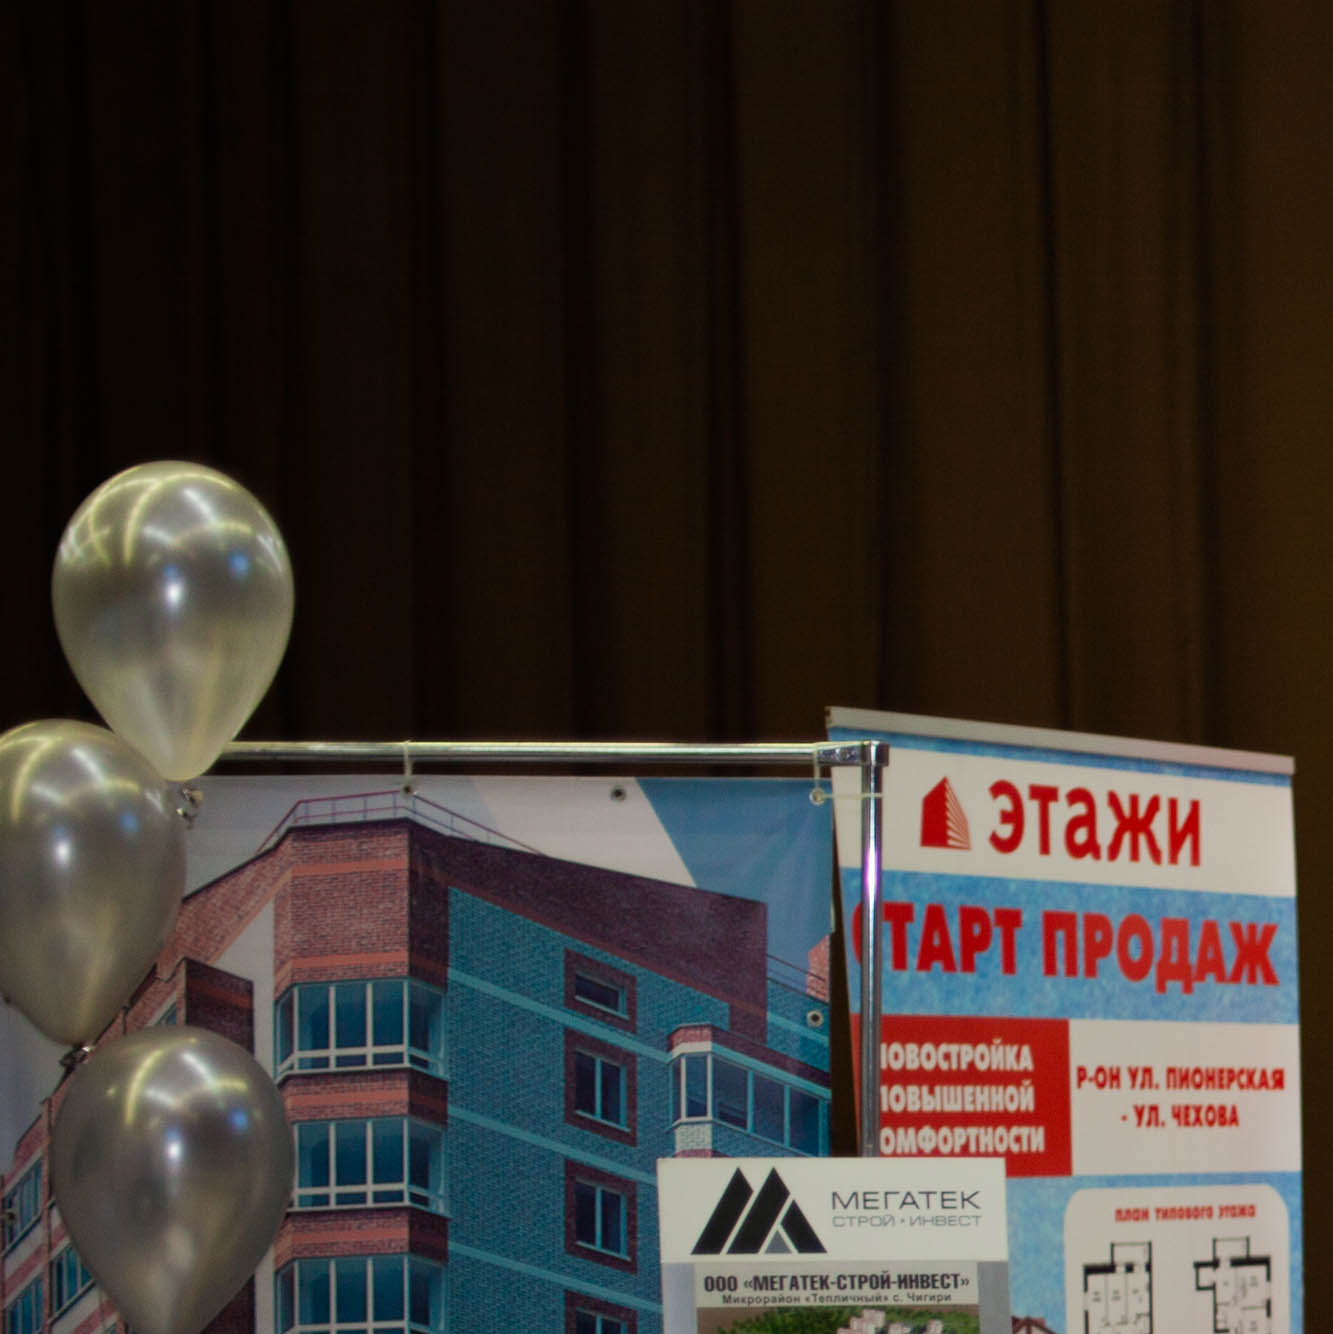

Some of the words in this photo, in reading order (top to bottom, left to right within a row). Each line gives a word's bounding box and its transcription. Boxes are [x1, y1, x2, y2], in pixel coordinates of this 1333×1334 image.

[852, 901, 1023, 975] ТАРТ
[1043, 910, 1280, 994] ПРОДАЖ
[1077, 1069, 1121, 1091] Р-ОН
[1128, 1067, 1160, 1091] УЛ.
[1166, 1067, 1286, 1091] ПИОНЕРСКАЯ
[1133, 1105, 1166, 1128] УЛ.
[1172, 1105, 1240, 1128] ЧЕХОВА
[880, 1125, 1045, 1156] ОМФОРТНОСТИ
[832, 1191, 981, 1210] МЕГАТЕК
[704, 1275, 738, 1292] ООО
[744, 1269, 969, 1291] «МЕГАТЕК-СТРОЙ-ИНВЕСТ»
[722, 1293, 800, 1305] Микрорайон
[805, 1293, 888, 1304] «Тепличный»
[907, 1293, 952, 1304] Чигири
